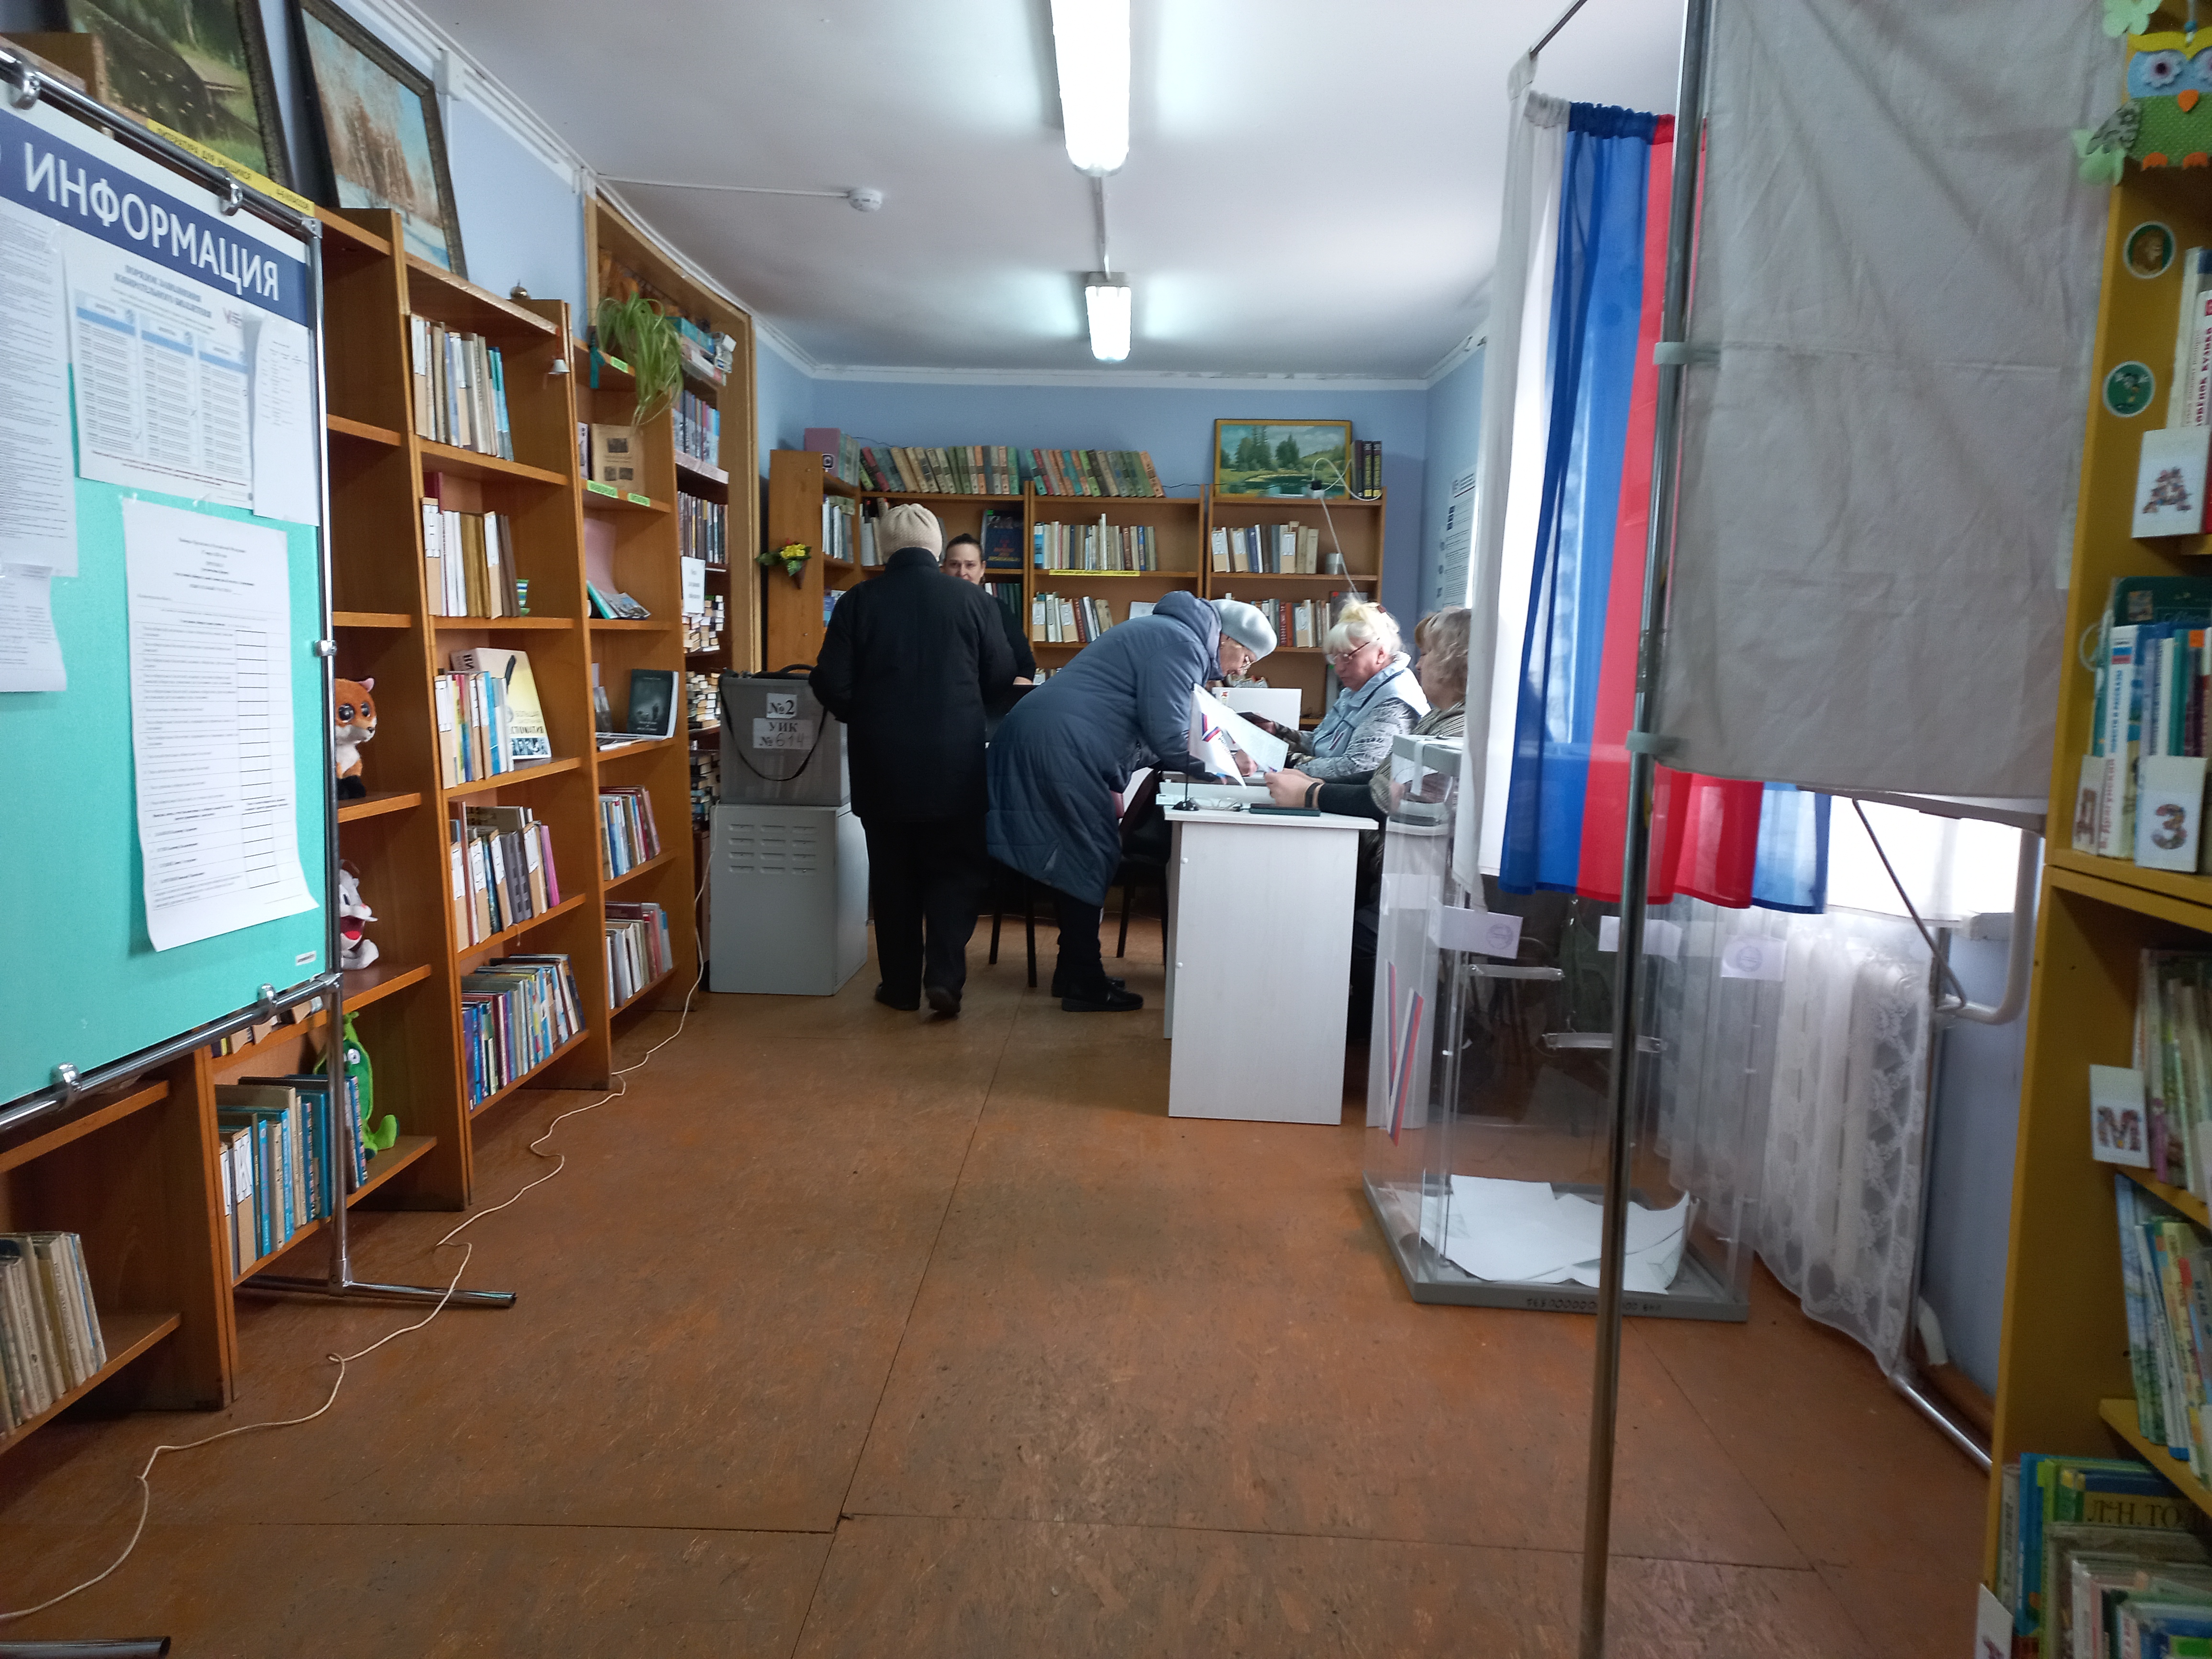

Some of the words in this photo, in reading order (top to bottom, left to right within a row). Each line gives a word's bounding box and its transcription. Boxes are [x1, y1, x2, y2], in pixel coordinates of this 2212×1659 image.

[24, 142, 279, 301] ИНФОРМАЦИЯ
[768, 699, 796, 715] №2
[768, 722, 798, 732] УИК
[2096, 1106, 2143, 1152] М
